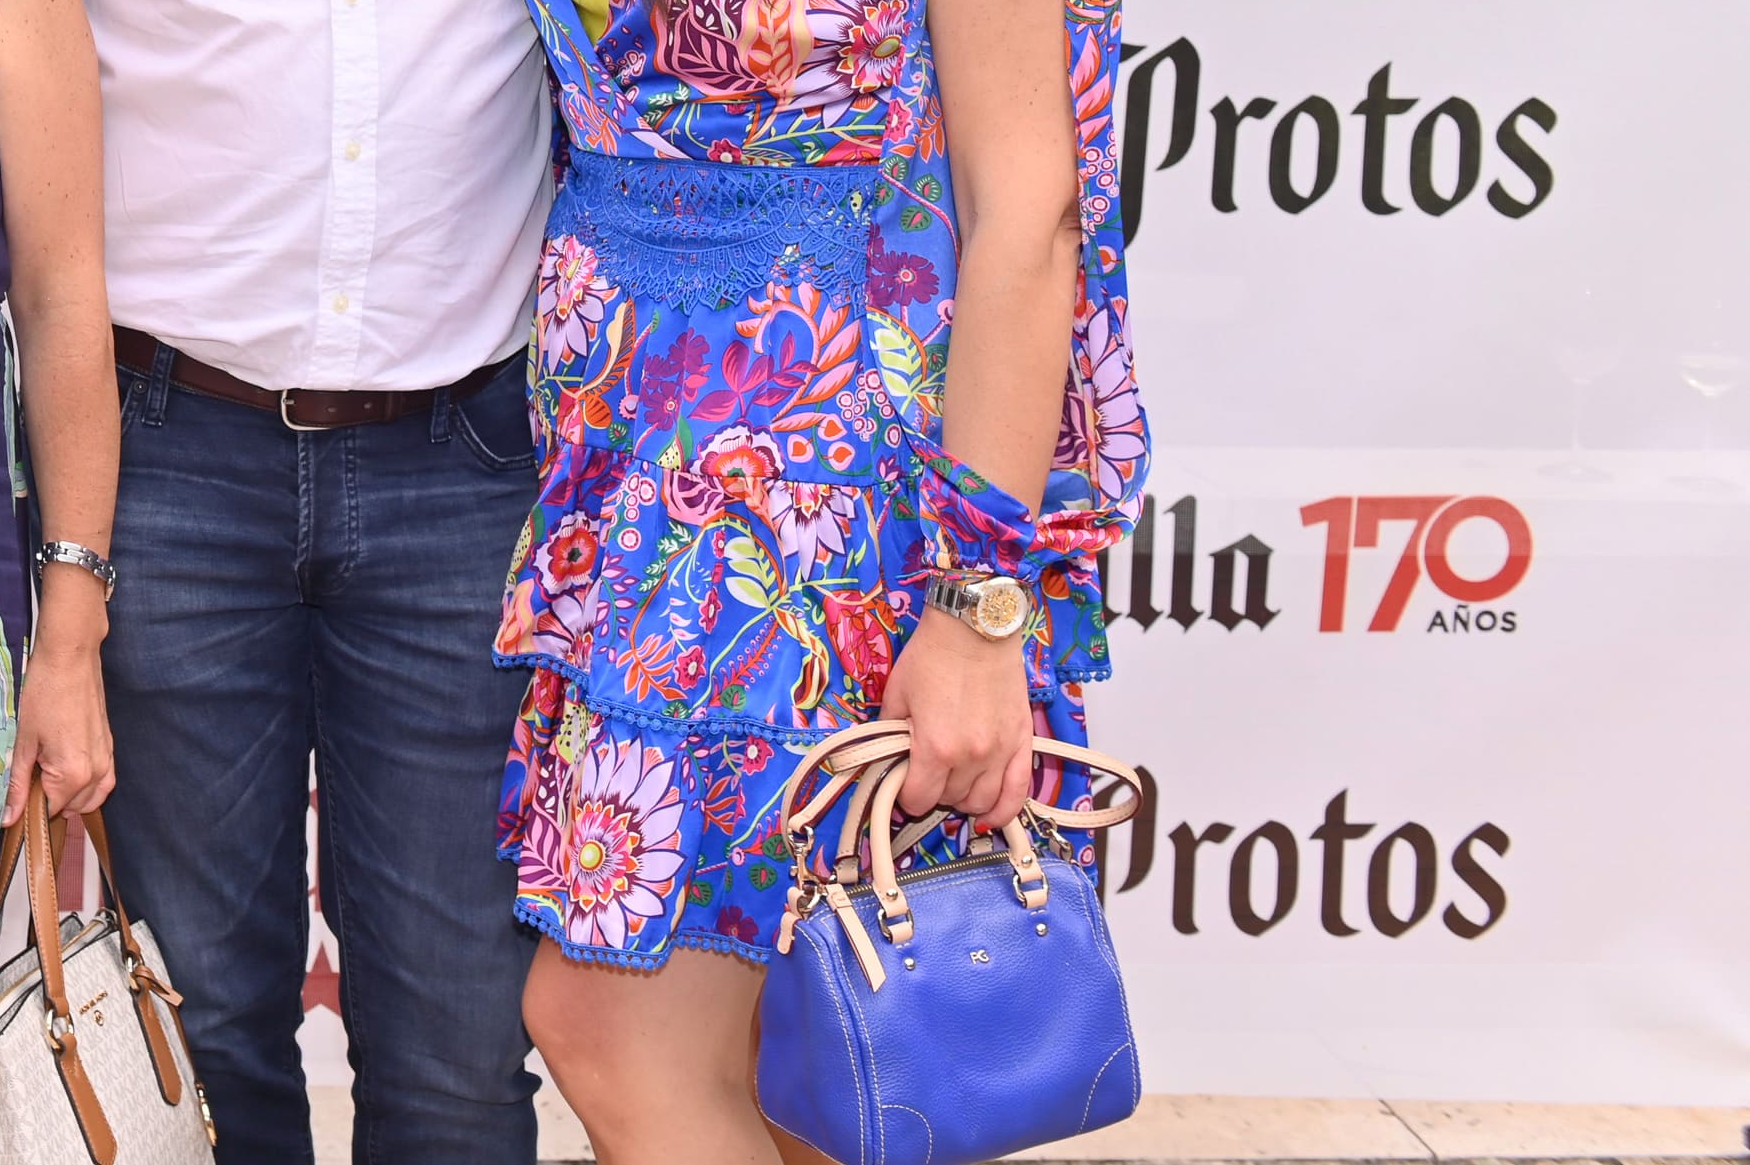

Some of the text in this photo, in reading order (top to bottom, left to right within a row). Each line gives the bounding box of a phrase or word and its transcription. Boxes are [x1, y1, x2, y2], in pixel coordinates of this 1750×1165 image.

[1118, 36, 1558, 250] Protos
[1299, 495, 1533, 633] 170
[1426, 604, 1518, 634] AÑOS
[1091, 765, 1511, 941] Protos
